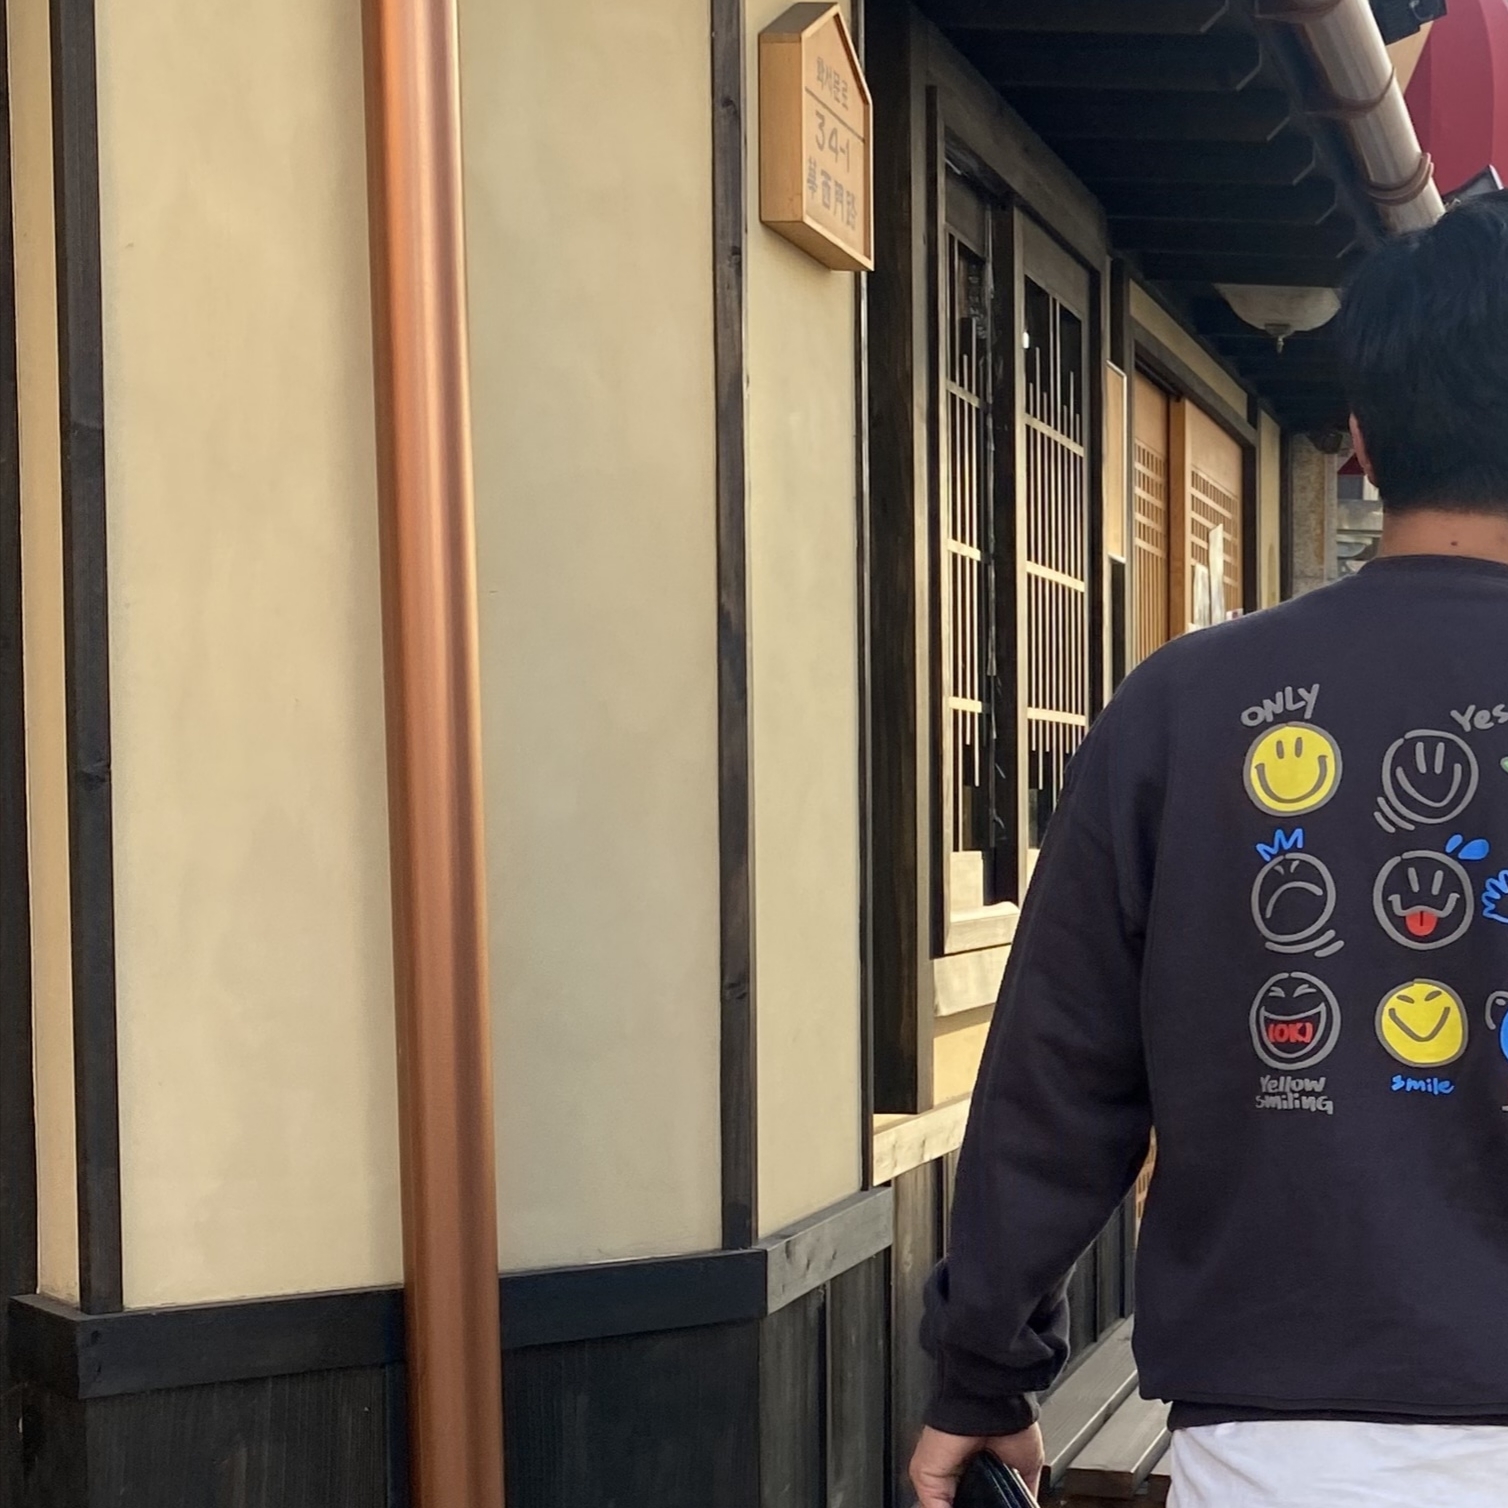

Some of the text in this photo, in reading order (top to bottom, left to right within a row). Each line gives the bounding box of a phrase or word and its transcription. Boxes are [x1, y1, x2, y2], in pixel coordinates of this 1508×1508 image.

[814, 110, 850, 173] 34-1
[1240, 684, 1320, 726] ONLY
[1260, 1074, 1327, 1093] Yellow
